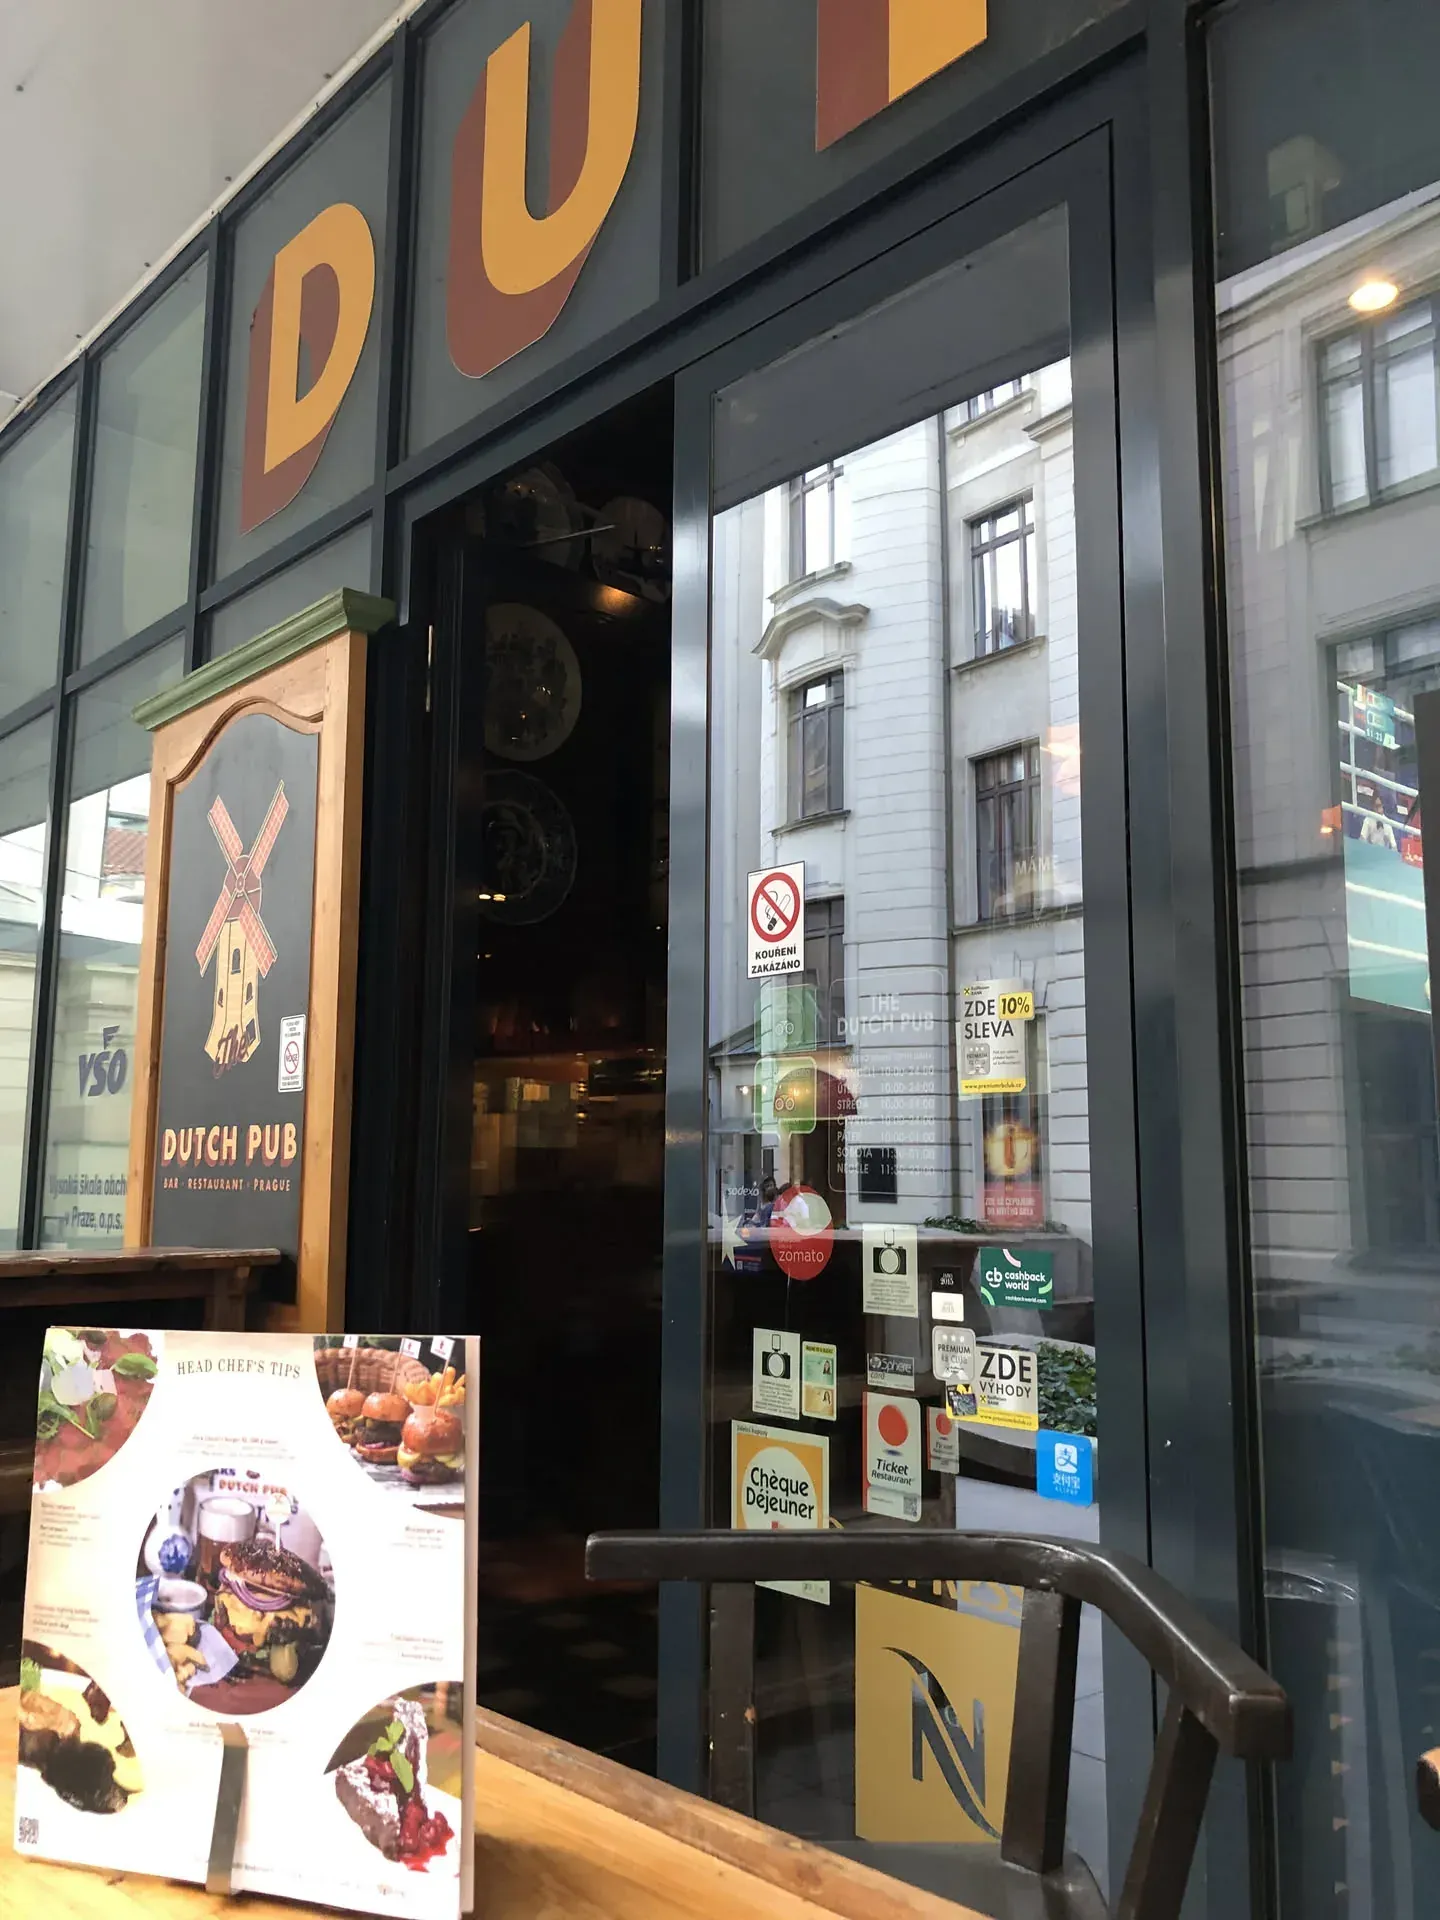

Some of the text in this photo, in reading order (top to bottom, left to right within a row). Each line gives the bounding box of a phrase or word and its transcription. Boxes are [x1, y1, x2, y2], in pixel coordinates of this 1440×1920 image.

[755, 943, 797, 960] KOUŘENÍ
[751, 958, 801, 974] ZAKÁZÁNO
[871, 994, 900, 1013] THE
[964, 996, 1030, 1017] ZDE 10%
[837, 1011, 935, 1036] DUTCH PUB
[964, 1020, 1014, 1040] SLEVA
[162, 1122, 297, 1166] DUTCH PUB
[163, 1177, 291, 1192] BAR RESTAURANT PRAGUE
[727, 1185, 760, 1196] sodexo
[99, 1211, 124, 1234] o.p.s.
[779, 1248, 824, 1262] zomato
[985, 1267, 1003, 1283] cb
[1004, 1270, 1046, 1283] cashback
[1004, 1281, 1030, 1291] world
[937, 1343, 971, 1354] PREMIUM
[177, 1358, 301, 1380] HEAD CHEF'S TIPS
[881, 1357, 913, 1374] Sphere
[980, 1351, 1032, 1383] ZDE
[979, 1378, 1032, 1399] VÝHODY
[876, 1458, 910, 1476] Ticket
[750, 1466, 809, 1497] Chèque
[871, 1469, 913, 1486] Restaurant
[218, 1479, 259, 1494] DUTCH
[746, 1486, 815, 1520] Déjeuner
